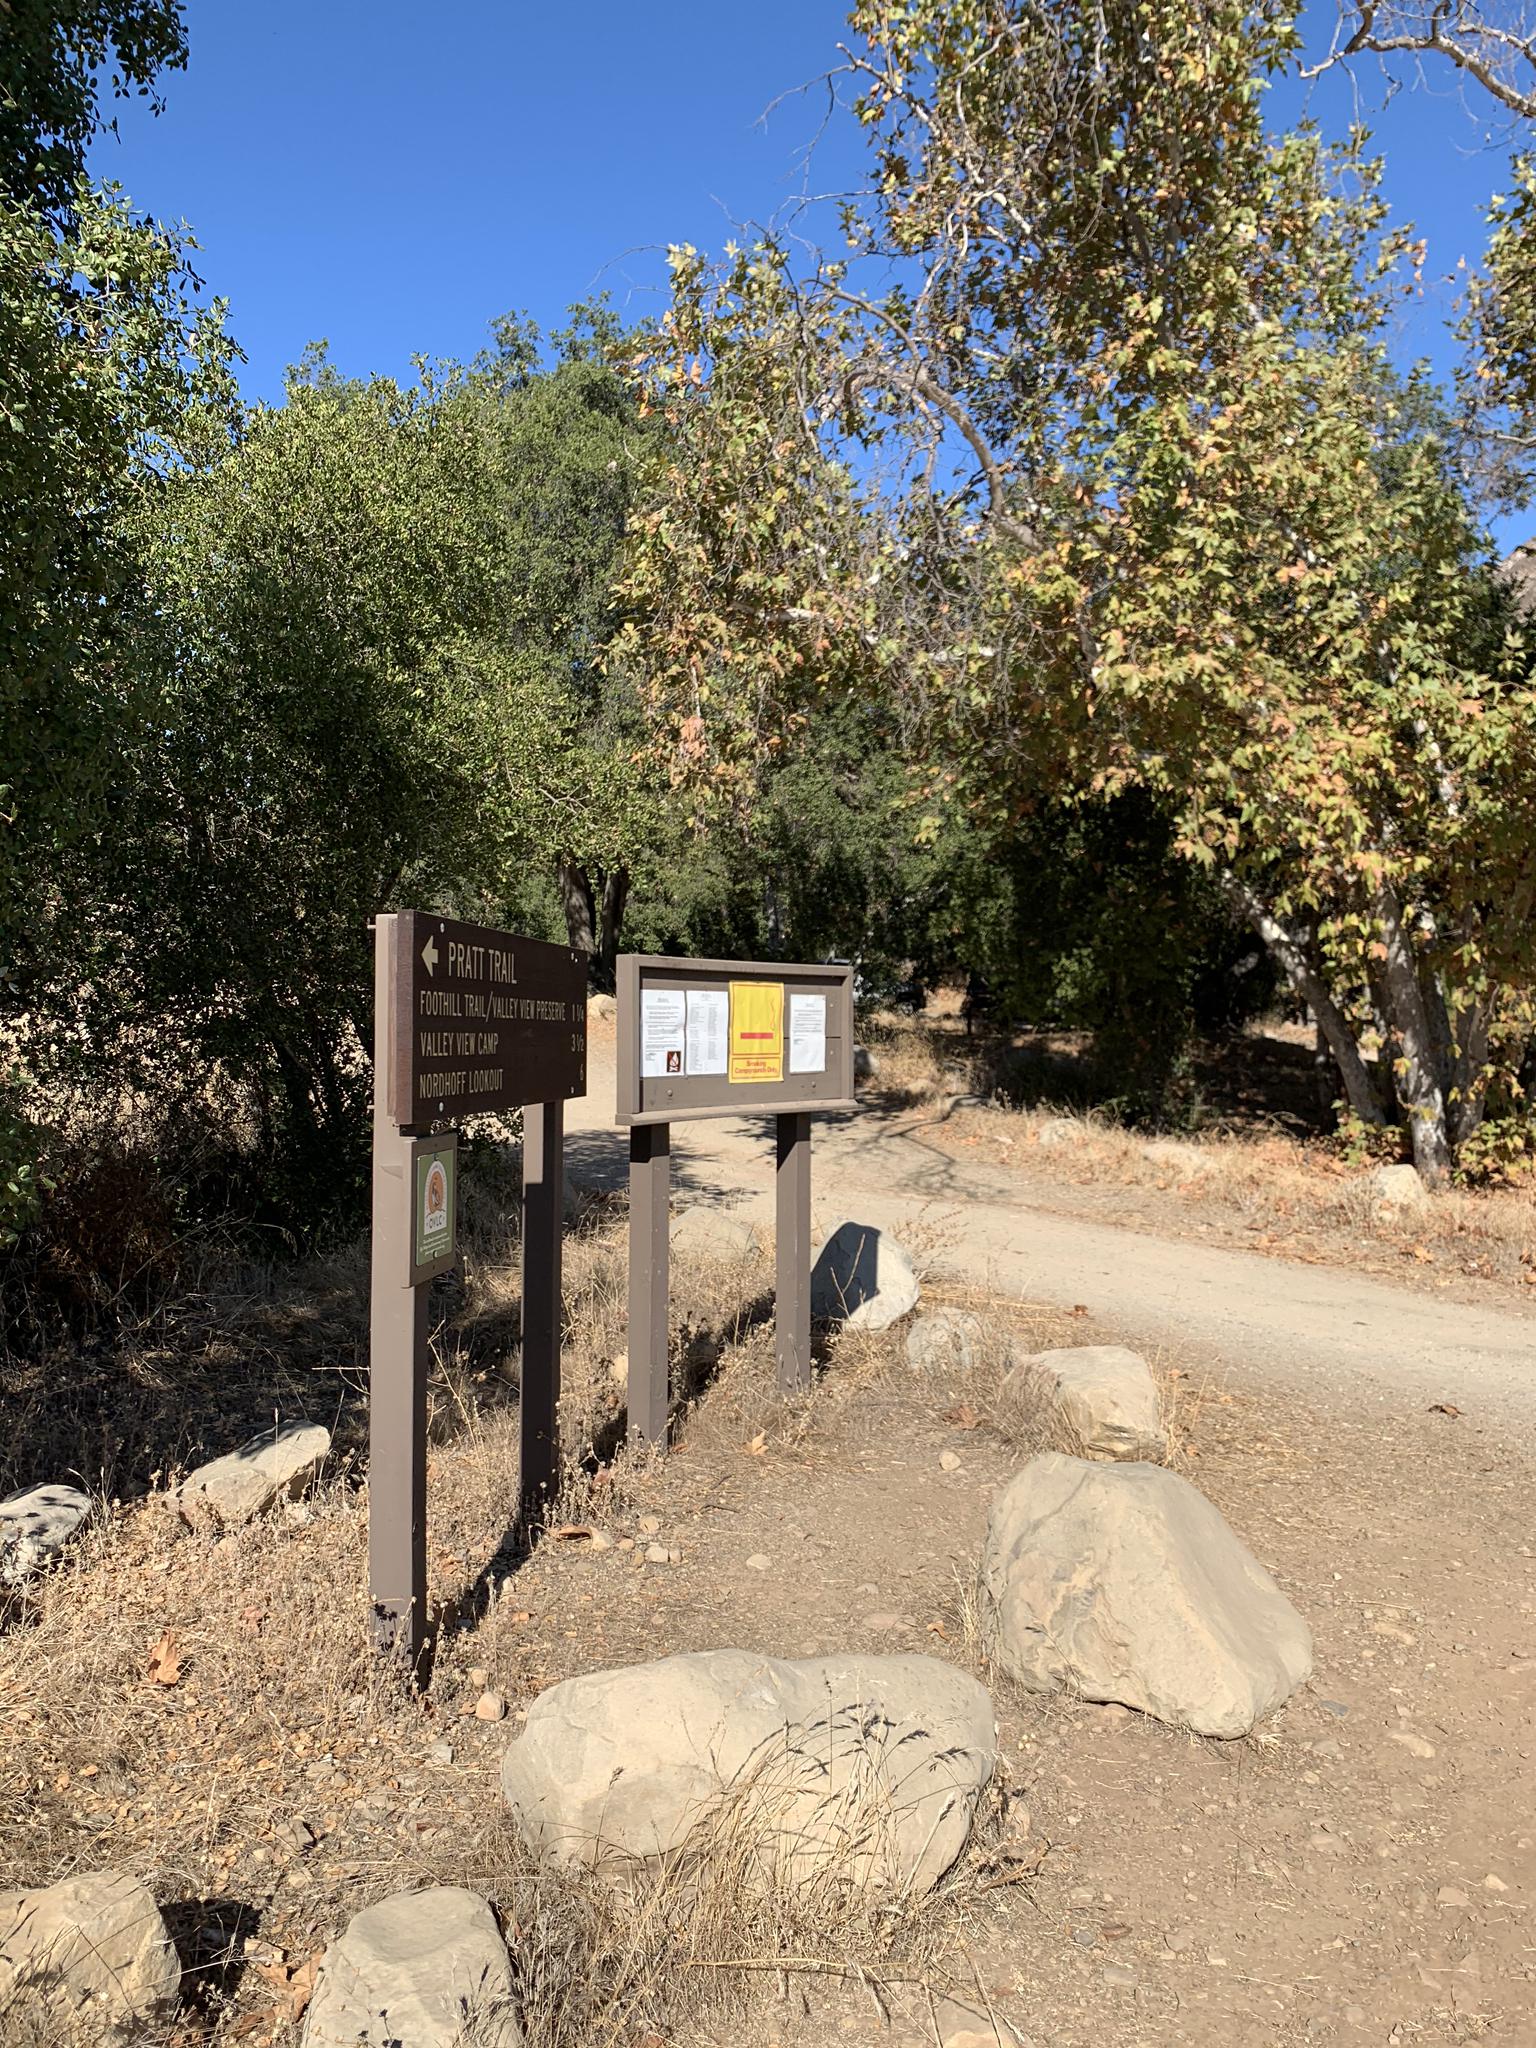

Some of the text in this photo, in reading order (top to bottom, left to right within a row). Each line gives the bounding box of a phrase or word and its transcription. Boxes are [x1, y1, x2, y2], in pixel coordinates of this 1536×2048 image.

[448, 942, 518, 984] PRATT TRAIL
[420, 990, 462, 1017] FOOTHILL
[464, 991, 520, 1023] TRAIL/VALLEY
[520, 1000, 535, 1020] VIEW
[536, 1001, 567, 1021] PRESERVE
[420, 1032, 454, 1057] VALLEY
[456, 1032, 475, 1056] VIEW
[477, 1032, 499, 1055] CAMP
[419, 1071, 467, 1099] NORDHOFF
[469, 1068, 504, 1094] LOOKOUT
